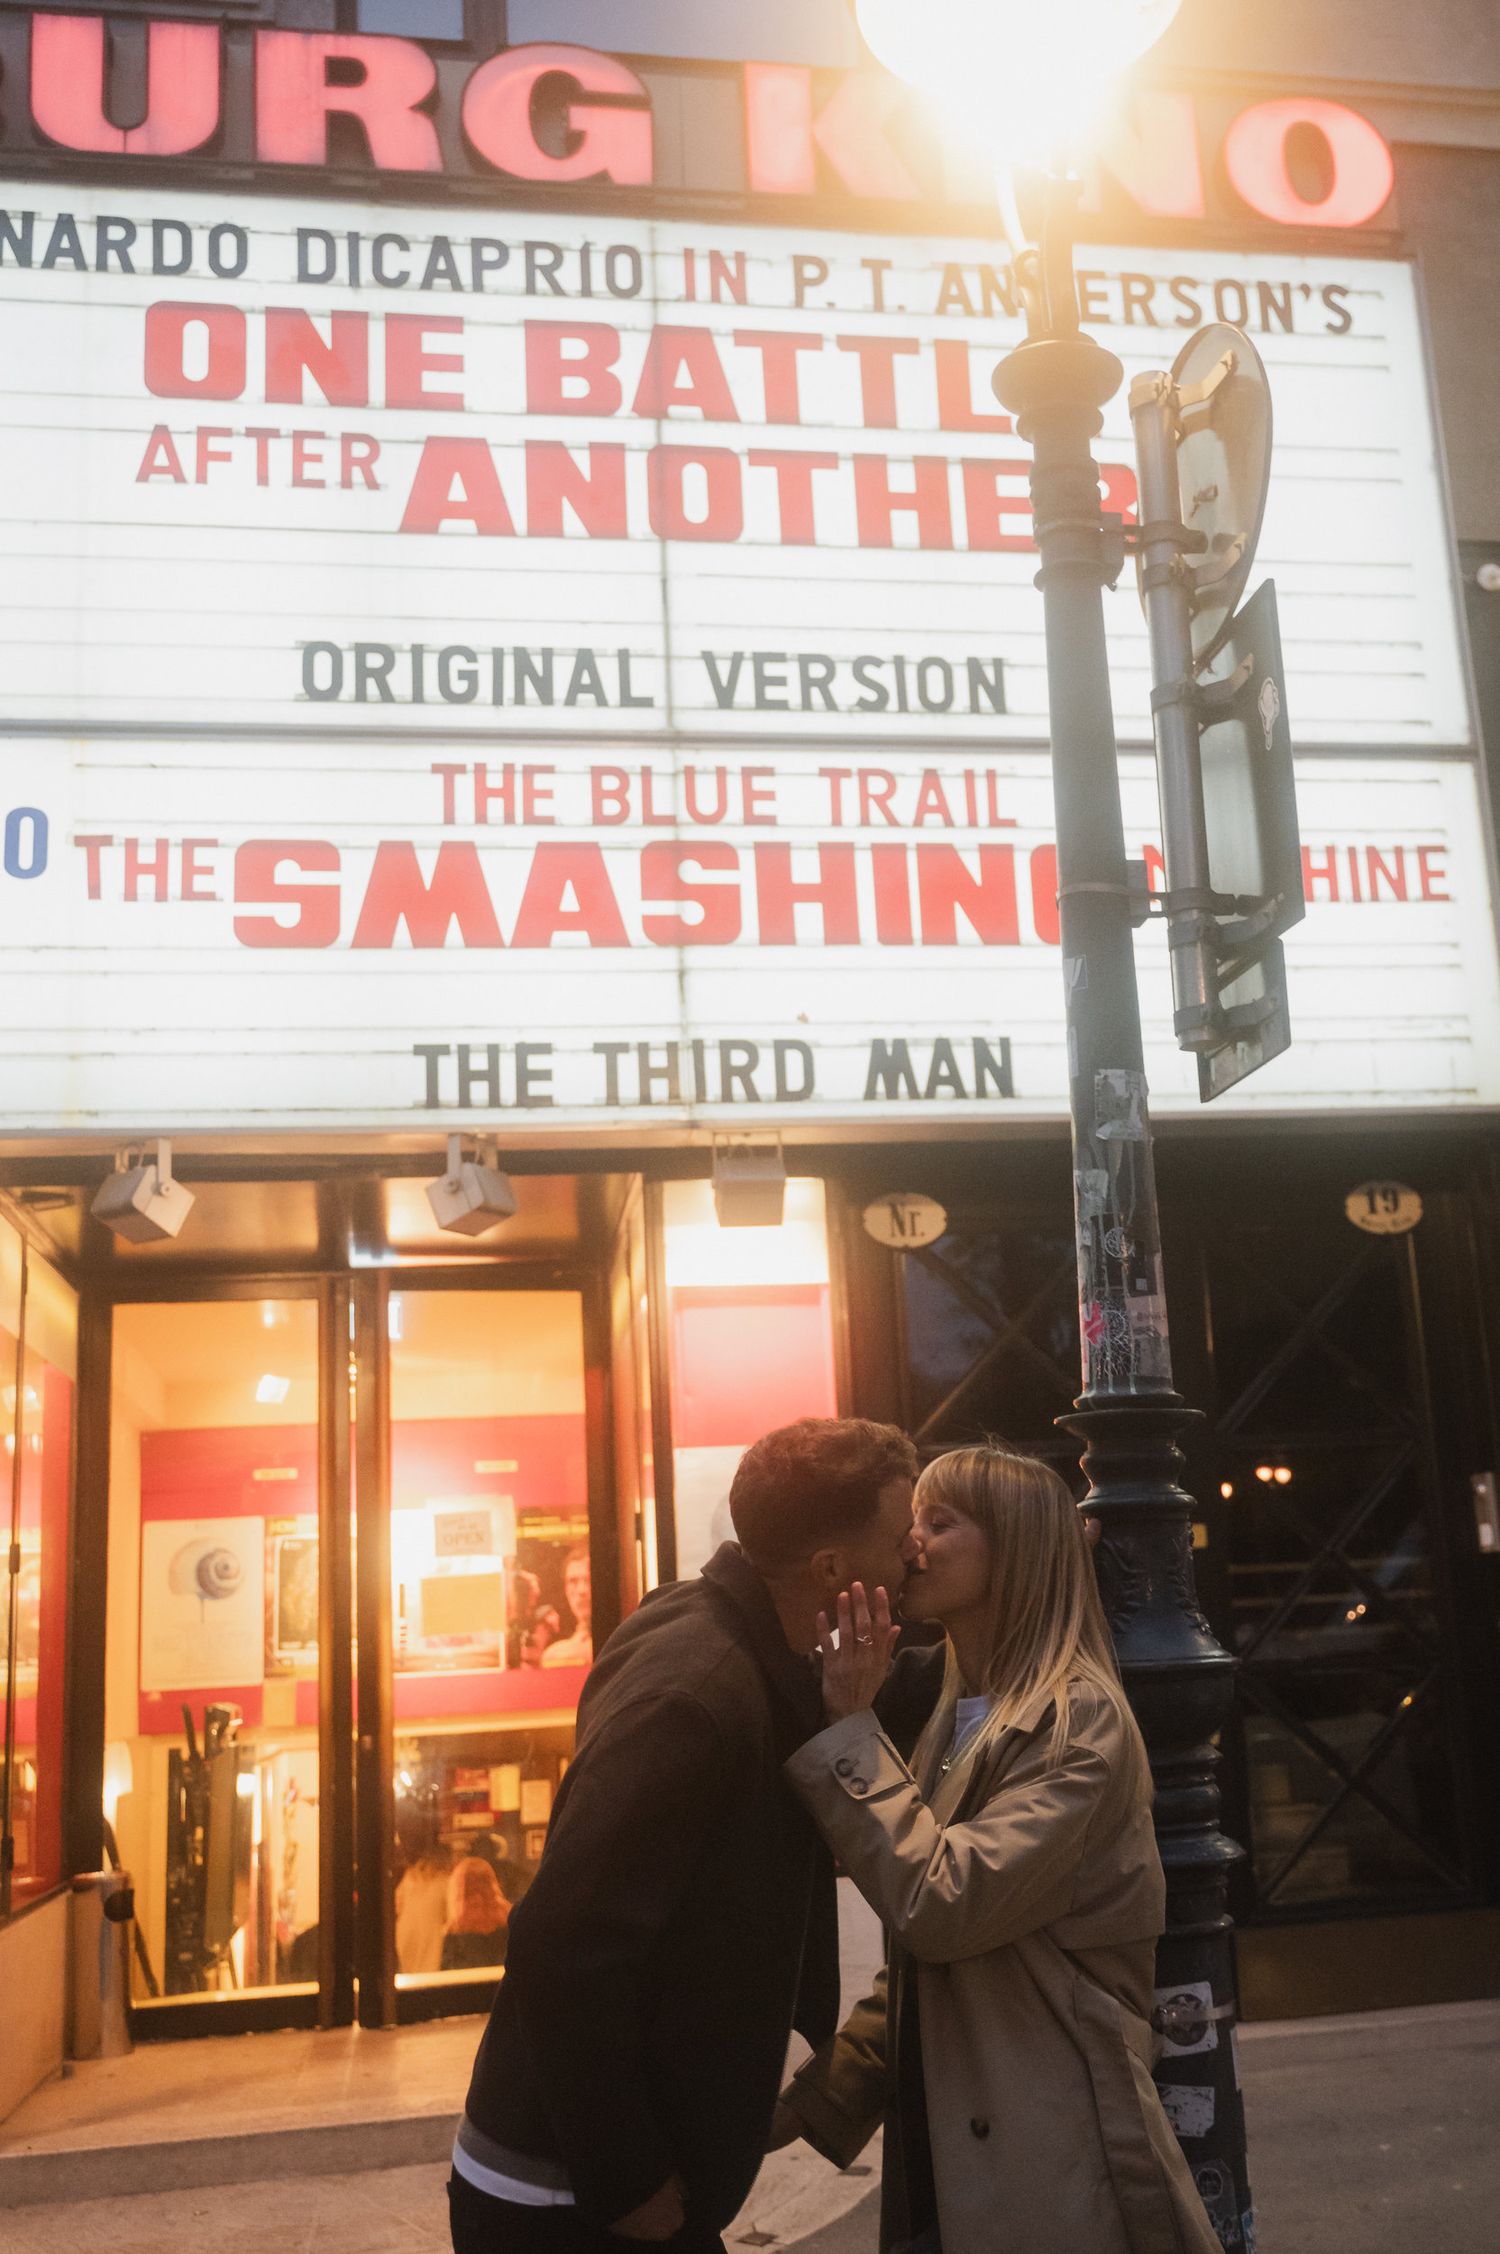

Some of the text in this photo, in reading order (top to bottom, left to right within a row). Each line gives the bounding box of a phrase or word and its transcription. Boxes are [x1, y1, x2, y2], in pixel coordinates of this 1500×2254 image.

[297, 226, 643, 299] DICAPRIO
[683, 247, 748, 304] IN
[934, 261, 1353, 336] ANERSON'S
[144, 300, 1012, 433] ONE BATTL
[135, 424, 382, 490] AFTER
[301, 641, 1009, 714] ORIGINAL VERSION
[430, 762, 1018, 828] THE BLUE TRAIL
[73, 834, 220, 902] THE
[413, 1036, 1016, 1109] THE THIRD MAN
